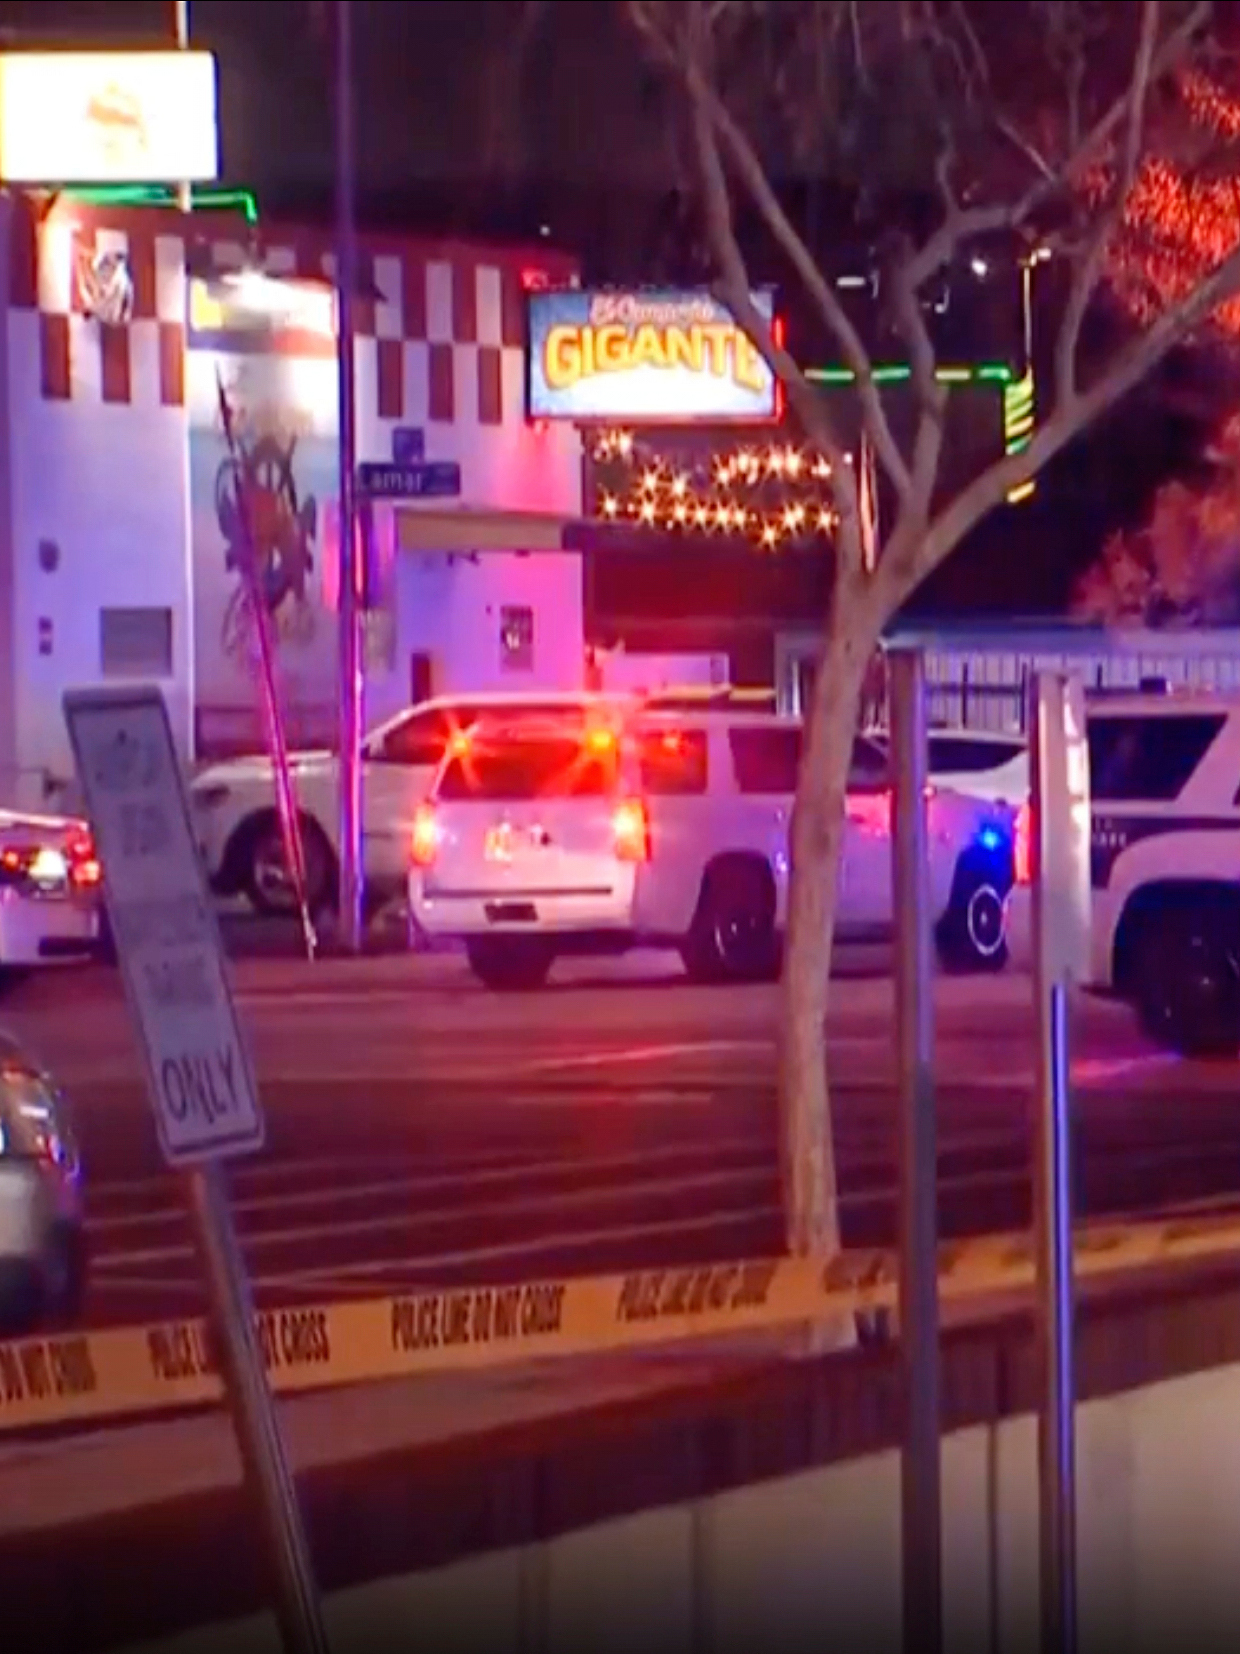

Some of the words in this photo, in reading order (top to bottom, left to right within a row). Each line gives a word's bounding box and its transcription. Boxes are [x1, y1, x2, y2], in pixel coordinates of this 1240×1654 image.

[544, 324, 768, 390] GIGANTE
[162, 1045, 239, 1125] ONLY
[280, 1310, 330, 1366] CROSS
[392, 1296, 440, 1352] POLICE
[522, 1284, 566, 1336] CROSS
